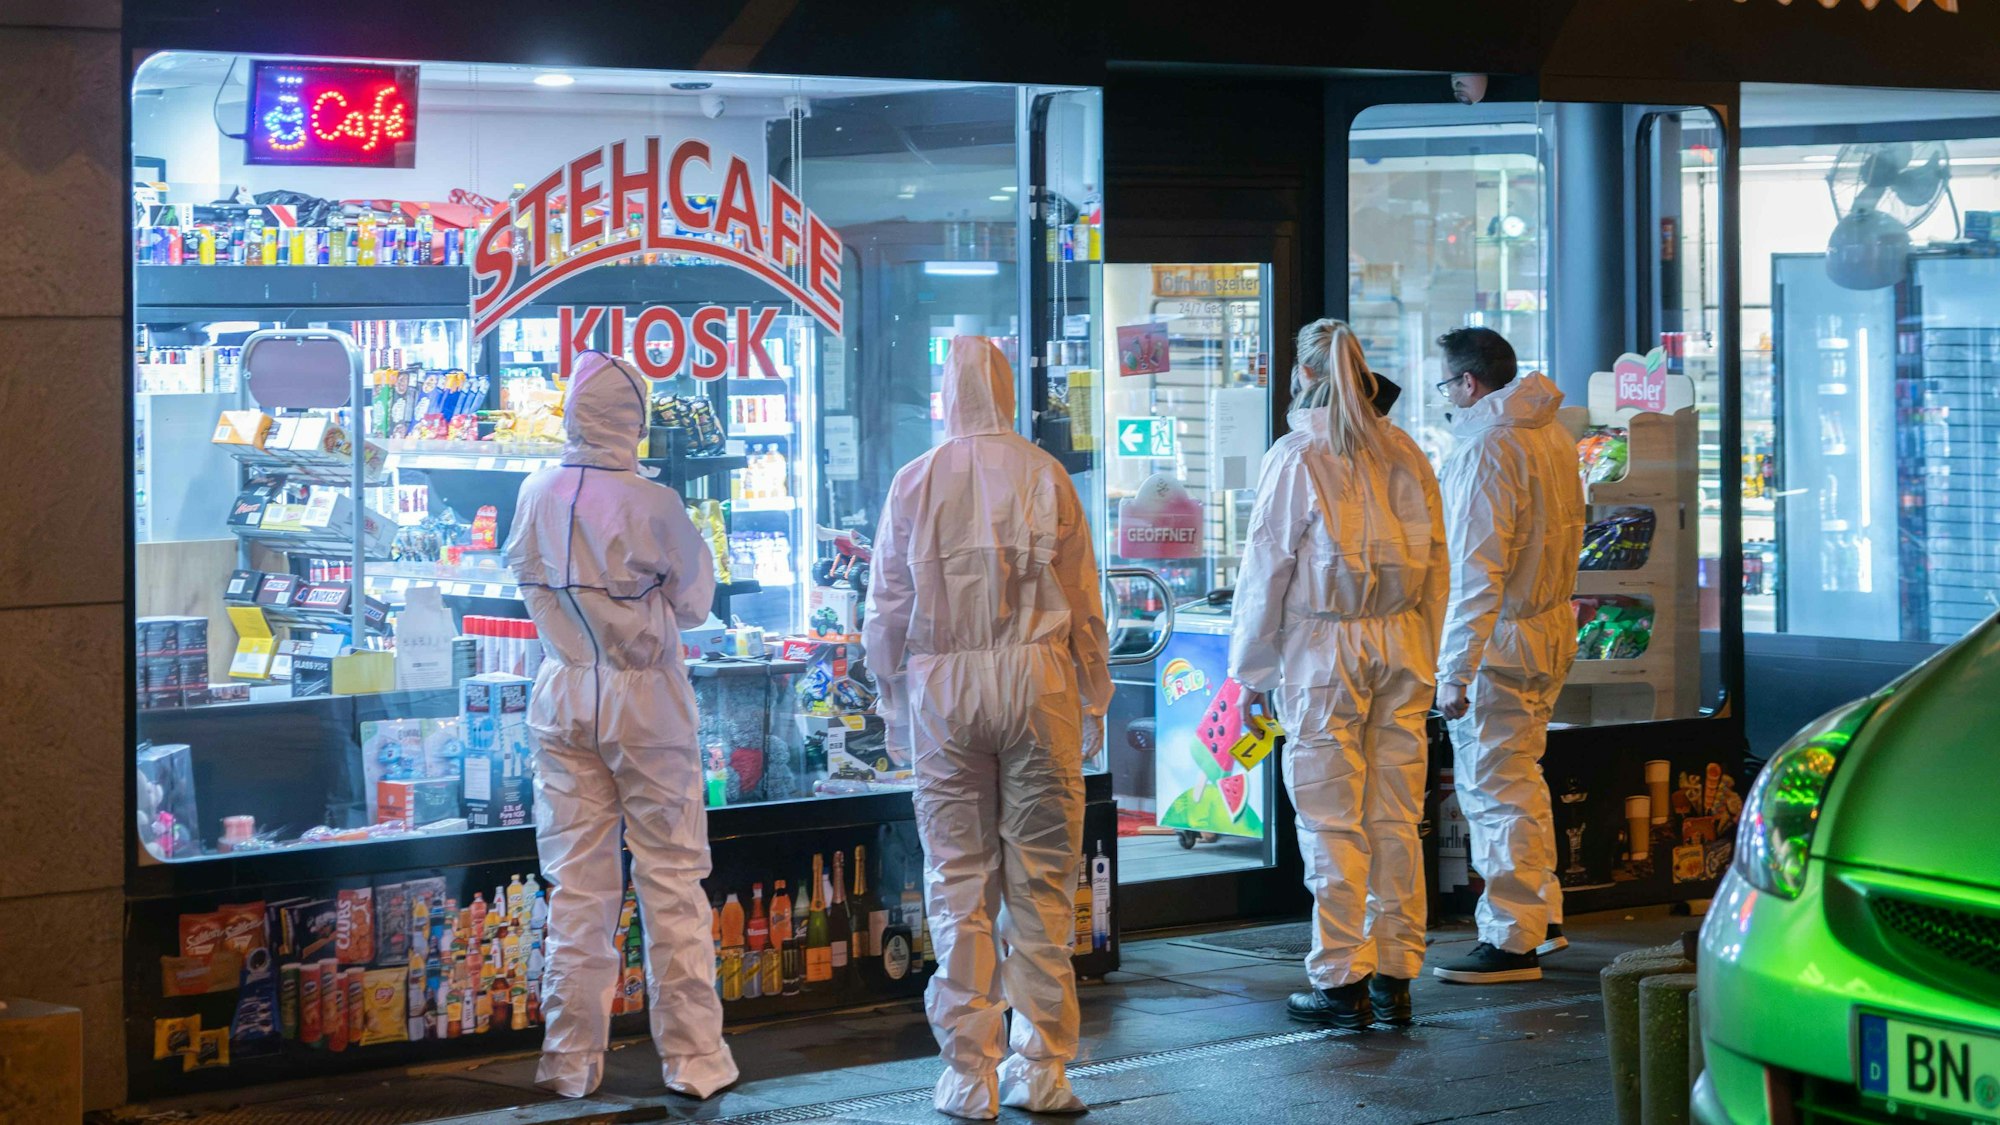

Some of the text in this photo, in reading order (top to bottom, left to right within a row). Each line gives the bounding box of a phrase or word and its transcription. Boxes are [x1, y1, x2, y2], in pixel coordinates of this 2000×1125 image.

[473, 135, 843, 319] STEHCAFE
[558, 305, 784, 382] KIOSK
[1620, 374, 1662, 400] besler
[336, 899, 352, 949] CLUBS
[1870, 1062, 1881, 1081] D
[1907, 1033, 1971, 1103] BN
